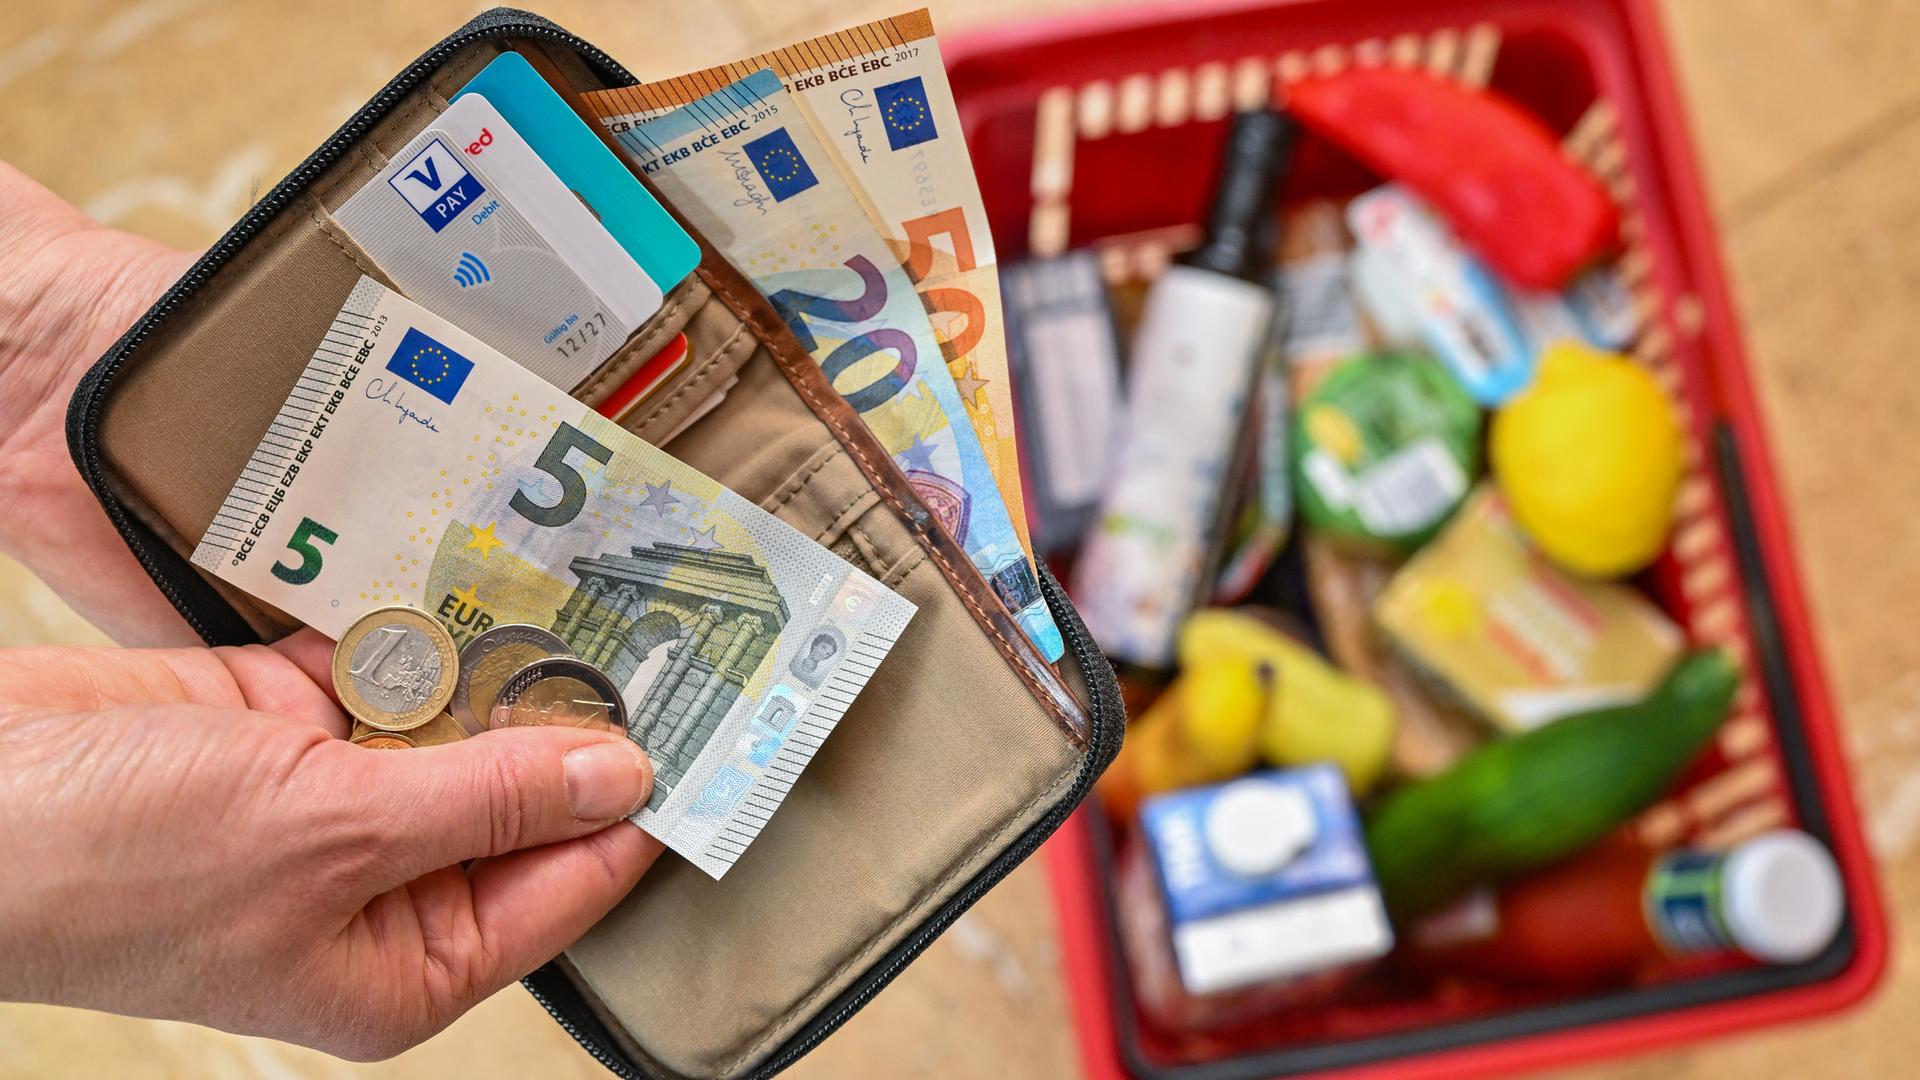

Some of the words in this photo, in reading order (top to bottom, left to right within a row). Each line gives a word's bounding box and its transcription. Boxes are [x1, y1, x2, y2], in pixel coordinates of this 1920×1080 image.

[795, 75, 825, 92] EKB
[861, 56, 892, 73] EBC
[895, 47, 919, 62] 2017
[642, 159, 660, 175] KT
[662, 147, 690, 166] EKB
[721, 119, 751, 140] EBC
[752, 104, 778, 123] 2015
[403, 156, 442, 191] V
[435, 186, 467, 218] PAY
[471, 200, 501, 225] Debit
[901, 206, 985, 364] 50
[543, 322, 569, 344] Gültig
[564, 312, 579, 326] bis
[557, 312, 606, 358] 12/27
[768, 254, 917, 414] 20
[250, 513, 270, 538] ECB
[280, 464, 300, 488] EZB
[295, 439, 314, 464] EKP
[310, 414, 330, 439] EKT
[324, 390, 345, 415] EKB
[354, 339, 376, 365] EBC
[370, 314, 389, 338] 2013
[508, 420, 615, 528] 5
[270, 516, 339, 585] 5
[347, 627, 408, 687] 1
